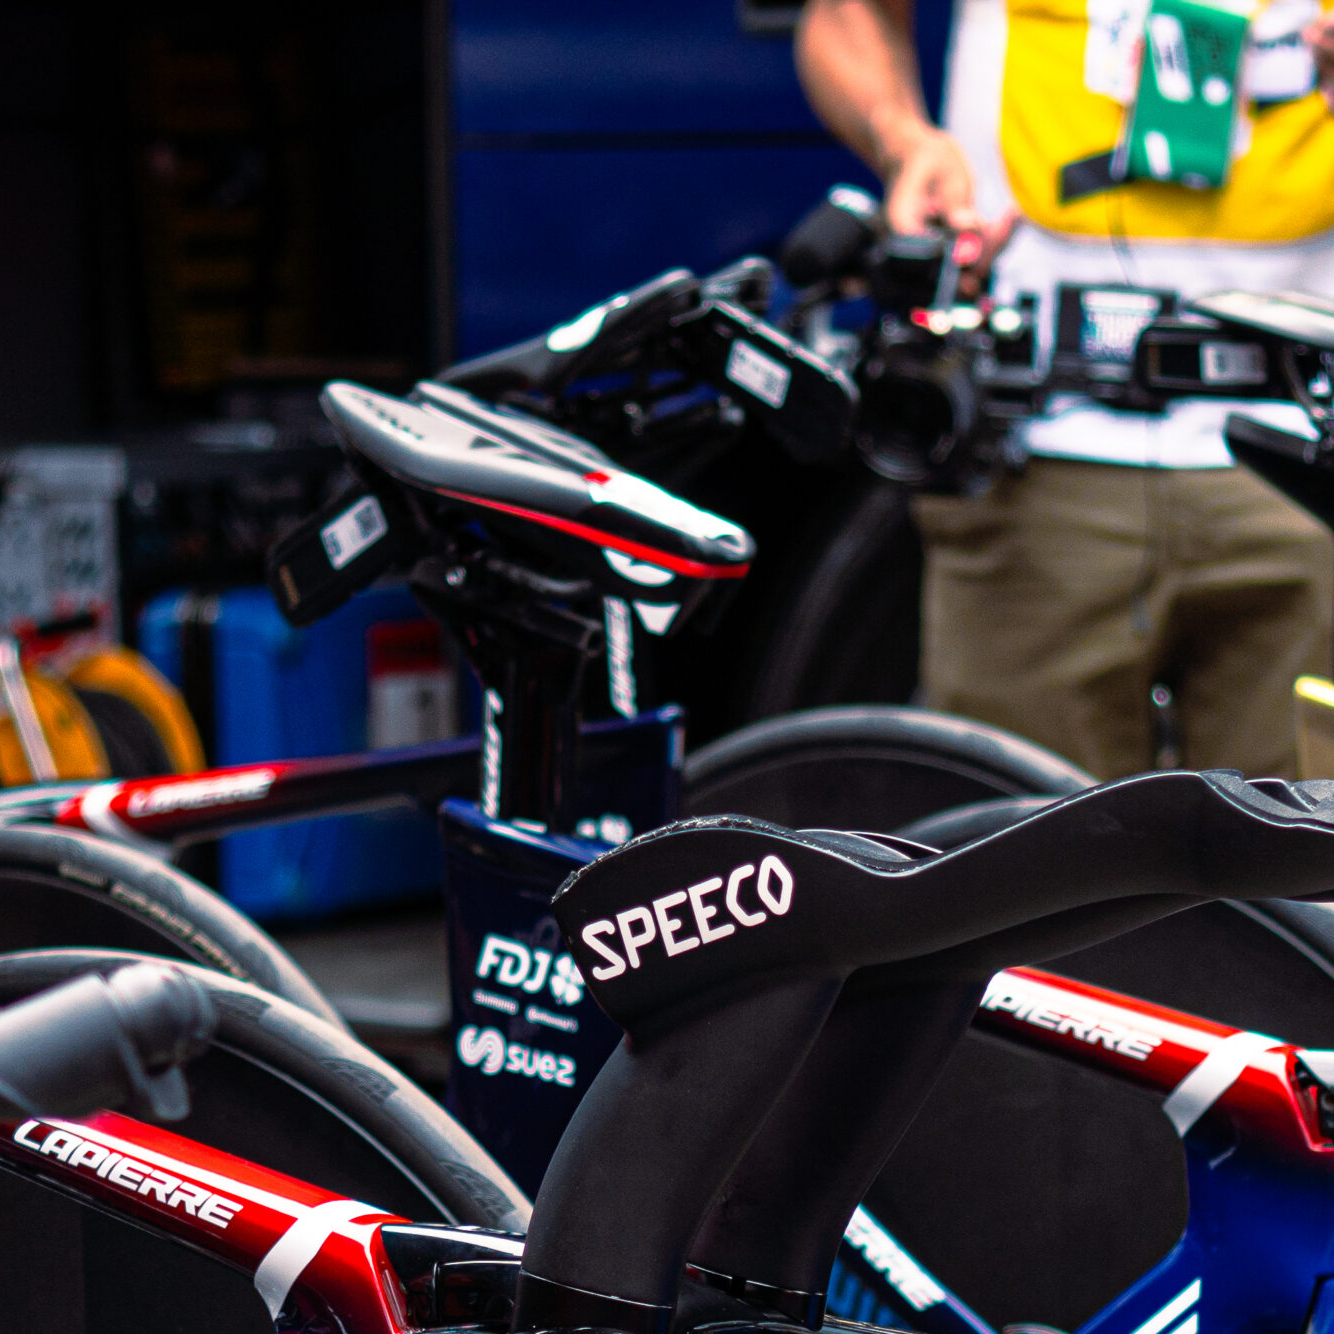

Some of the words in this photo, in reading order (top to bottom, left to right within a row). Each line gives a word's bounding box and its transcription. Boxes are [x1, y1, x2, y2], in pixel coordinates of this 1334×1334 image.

[476, 935, 551, 992] FDJ
[581, 854, 794, 982] SPEECO
[13, 1120, 244, 1229] LAPIERRE
